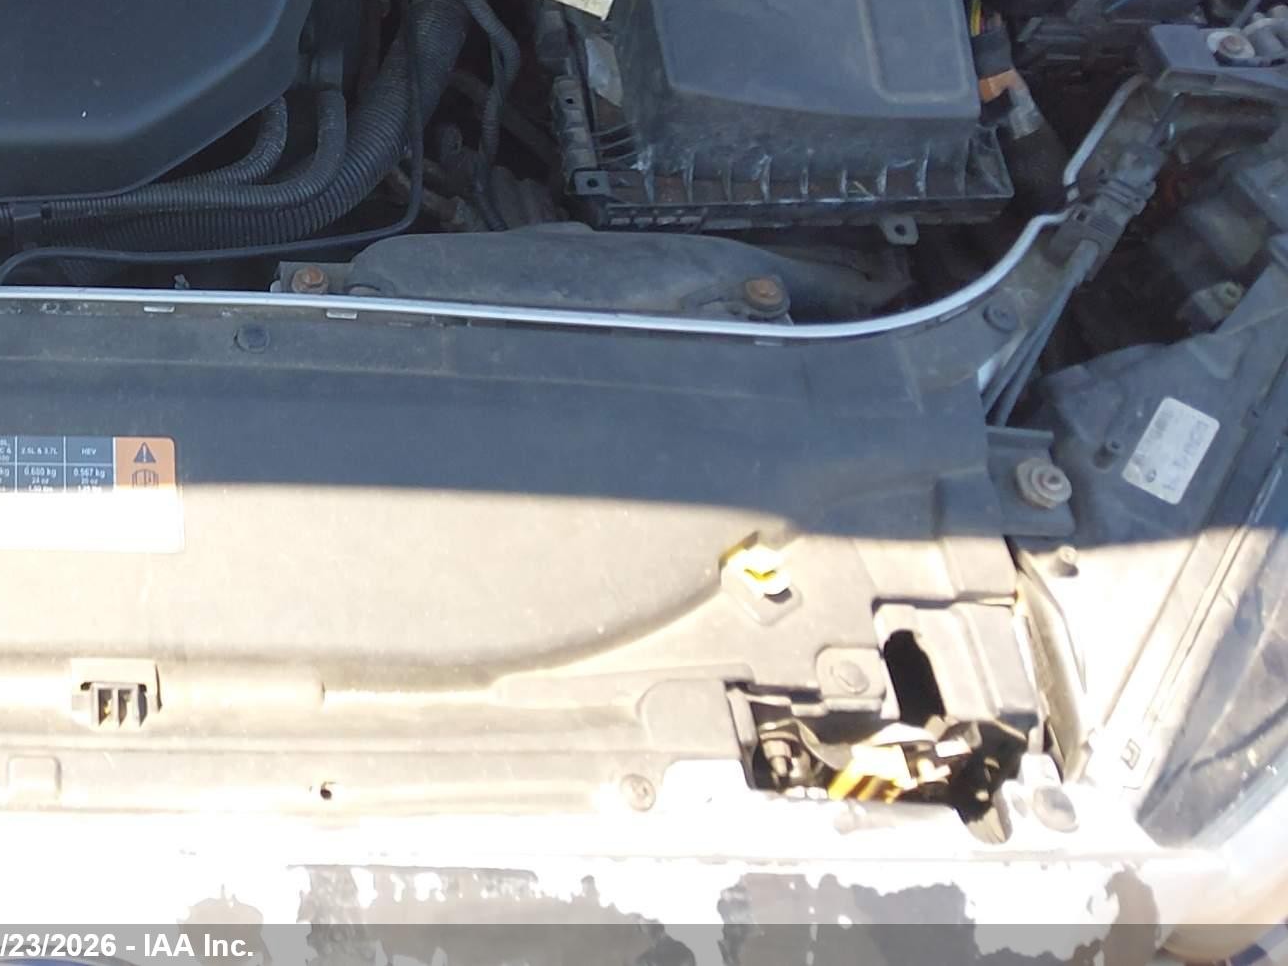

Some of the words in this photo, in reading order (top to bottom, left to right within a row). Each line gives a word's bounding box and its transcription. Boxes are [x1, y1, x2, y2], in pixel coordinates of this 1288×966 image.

[81, 447, 97, 455] HEV
[0, 466, 10, 477] kg
[46, 467, 57, 478] kg
[95, 467, 106, 479] kg
